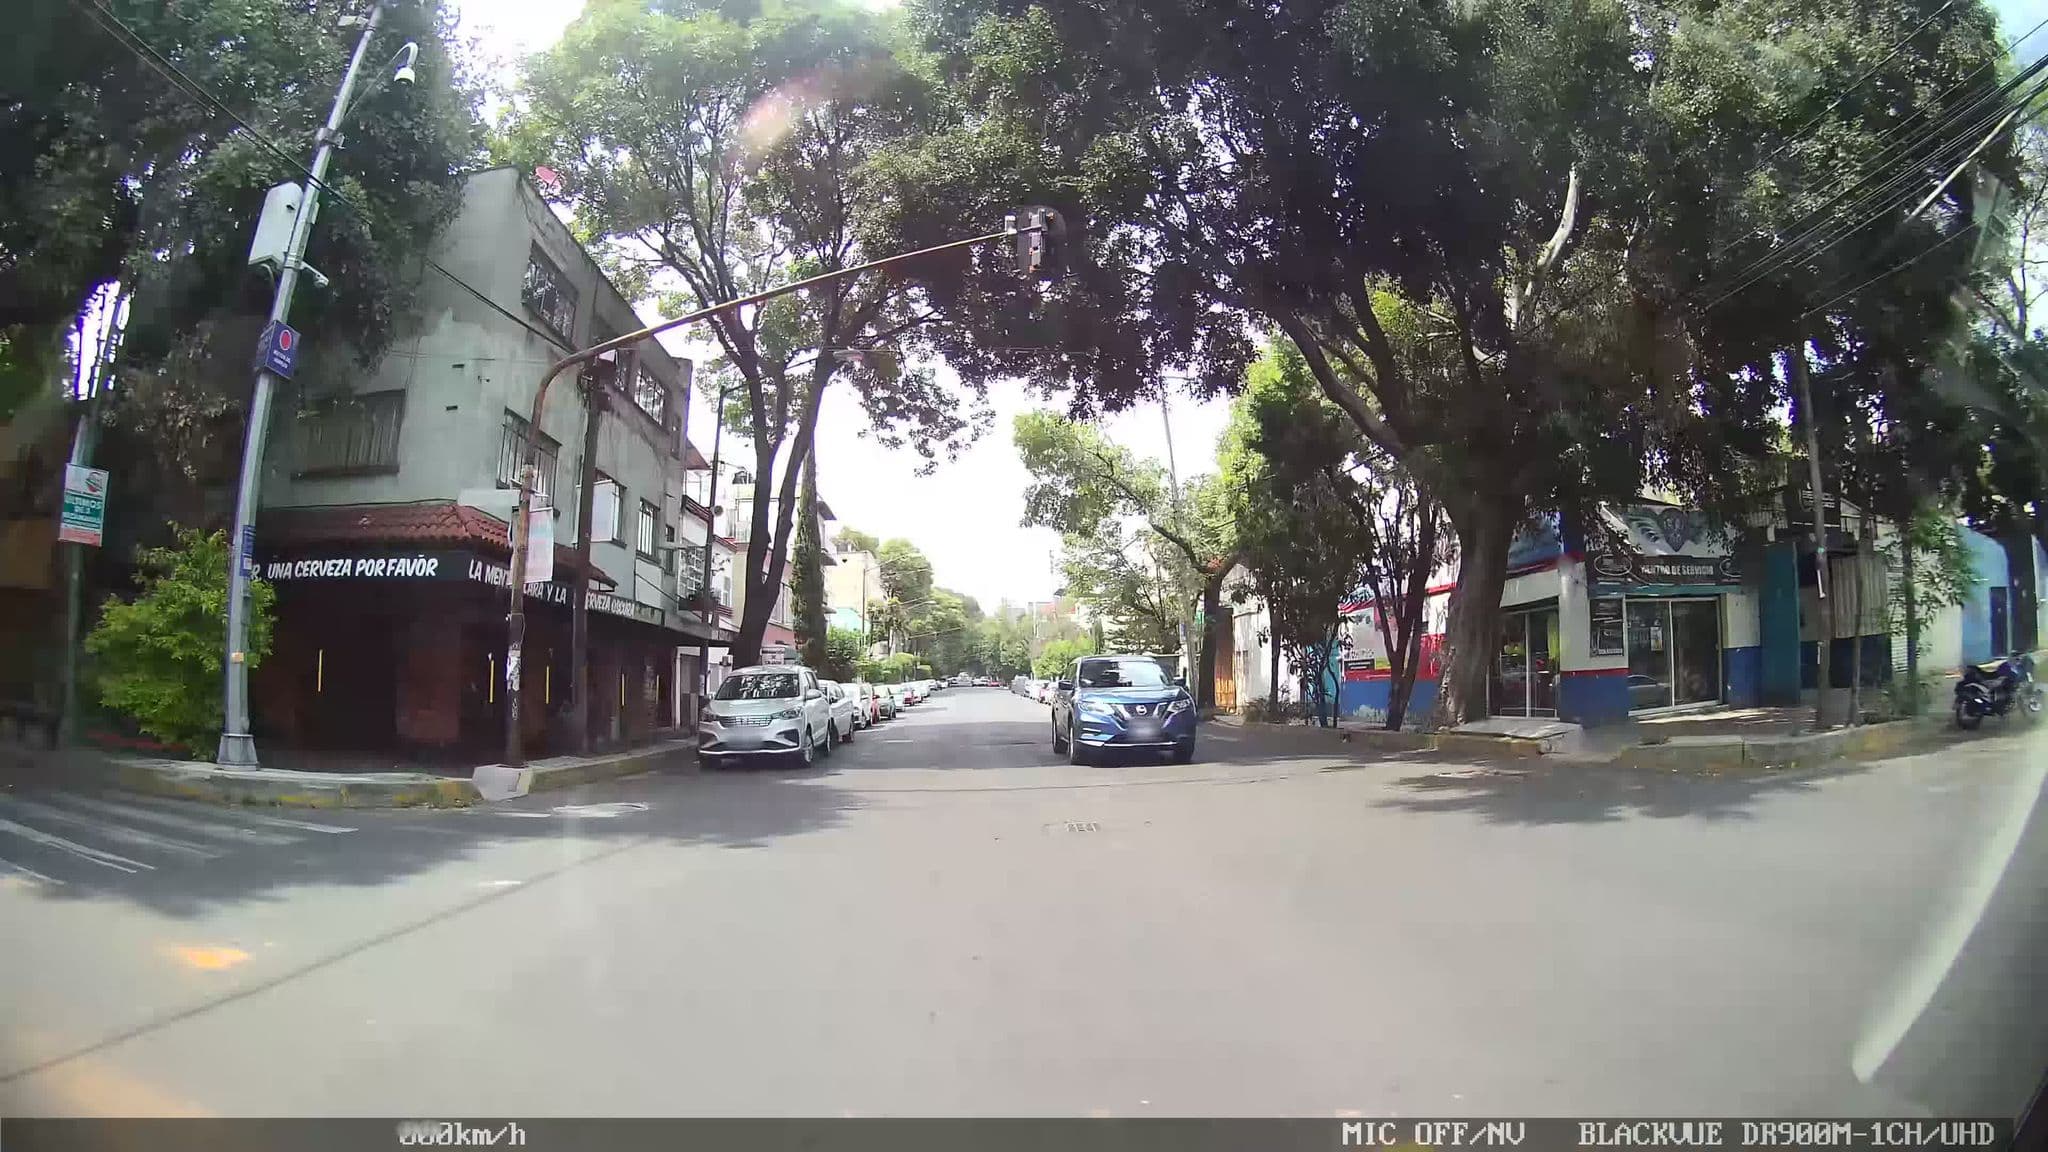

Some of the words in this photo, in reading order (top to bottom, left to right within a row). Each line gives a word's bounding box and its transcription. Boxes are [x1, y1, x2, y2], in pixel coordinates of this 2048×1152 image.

[267, 562, 292, 580] UNA
[295, 557, 352, 578] CERVEZA
[355, 558, 386, 577] POR
[1672, 565, 1681, 575] DE
[1682, 564, 1714, 576] SERVICIO
[468, 558, 483, 583] LA
[485, 564, 508, 589] MENT
[523, 583, 544, 600] LARA
[547, 583, 554, 602] Y
[555, 586, 567, 605] LA
[573, 590, 611, 613] ERVEZA
